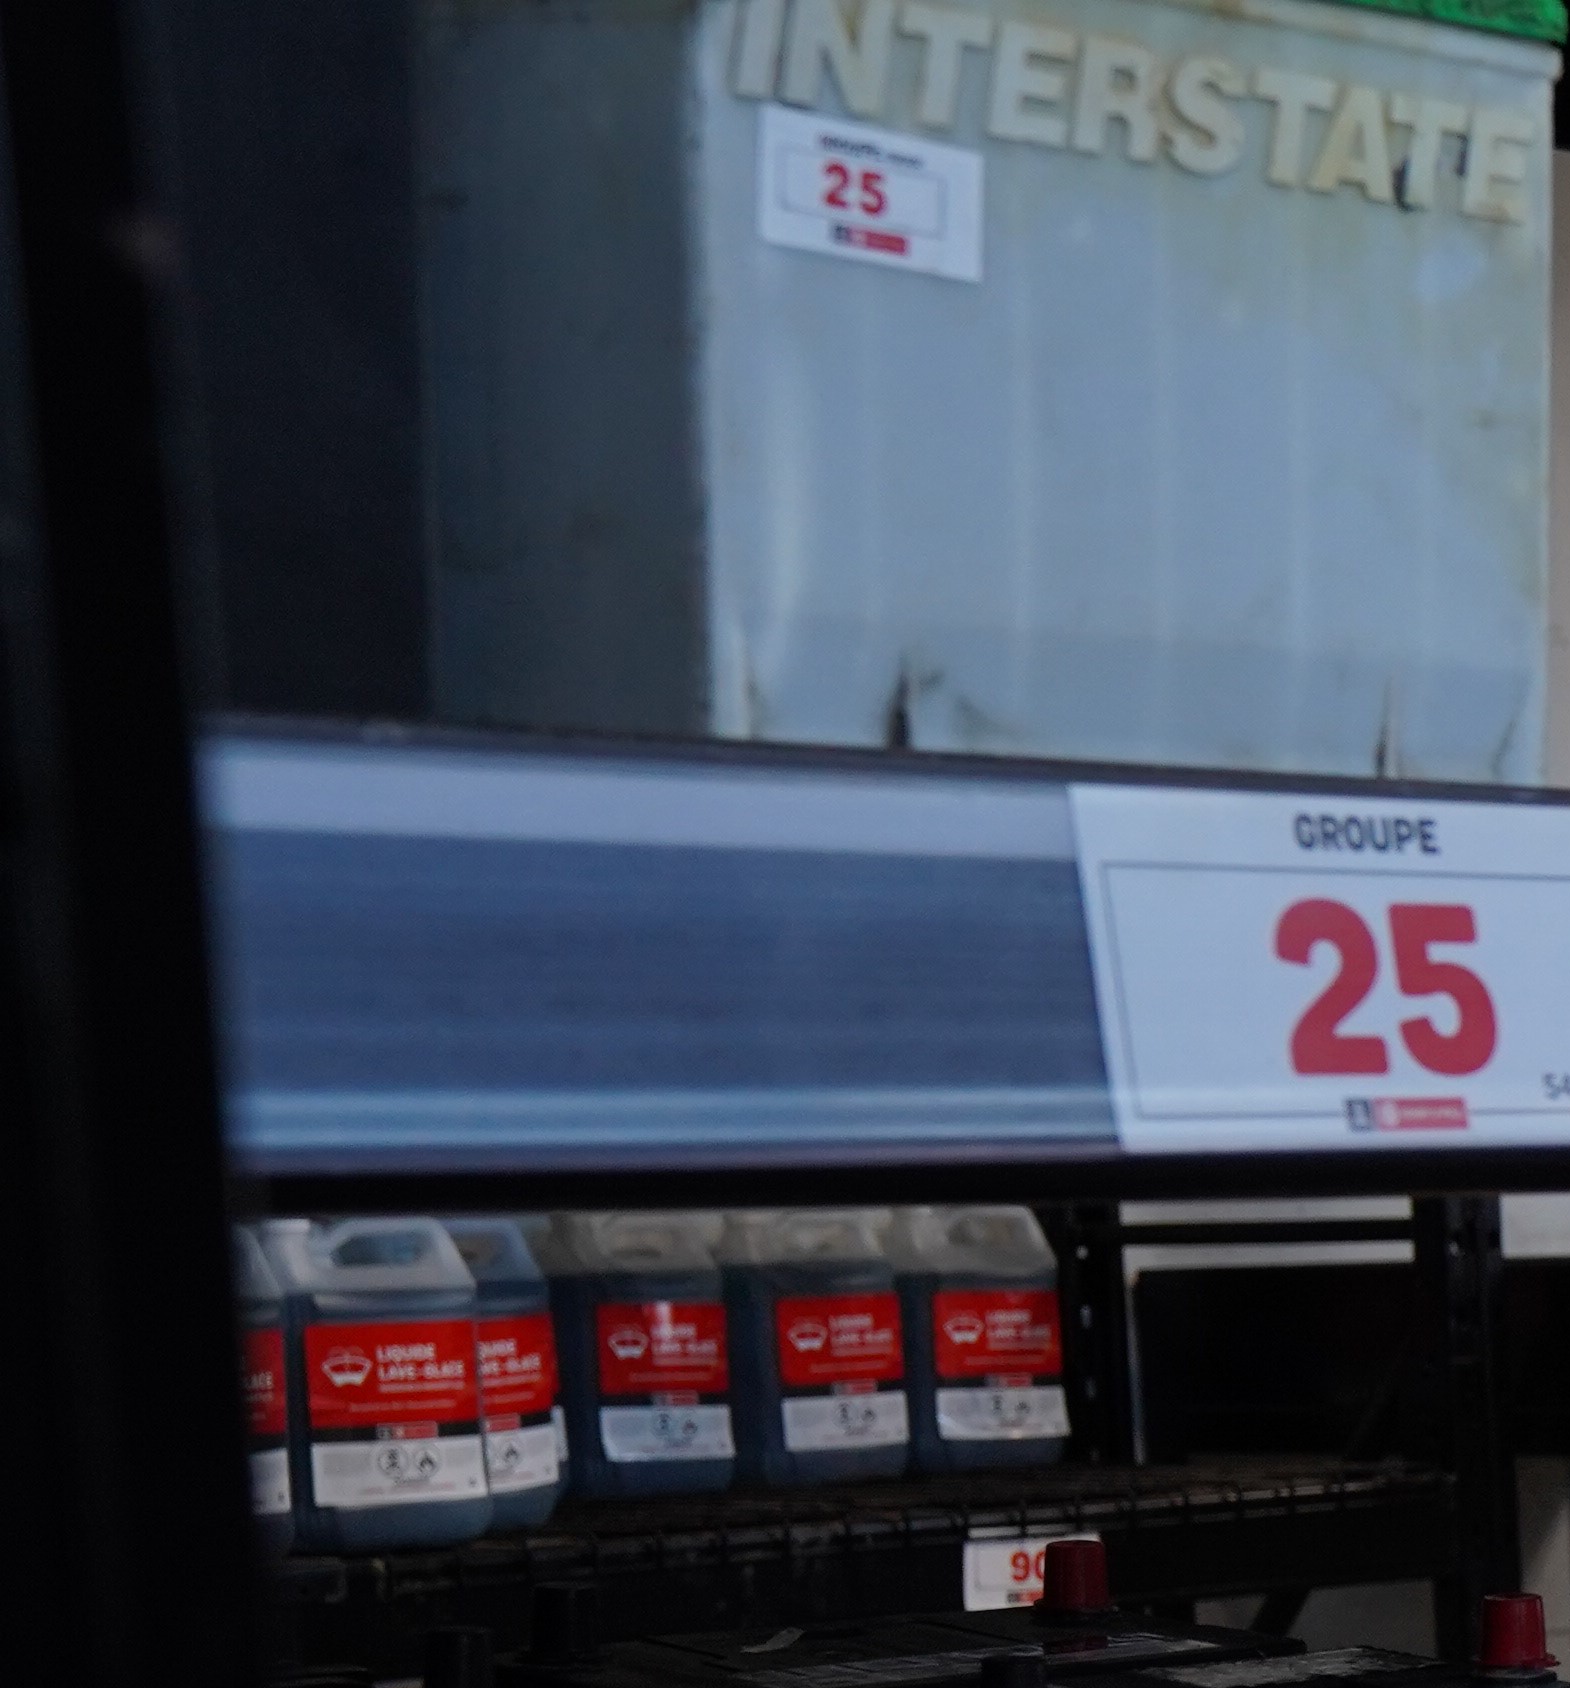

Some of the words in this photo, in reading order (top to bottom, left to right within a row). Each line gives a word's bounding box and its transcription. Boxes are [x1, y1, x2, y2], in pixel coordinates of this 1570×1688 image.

[730, 0, 1538, 228] INTERSTATE
[822, 162, 886, 217] 25
[1294, 813, 1440, 857] GROUPE
[1275, 898, 1497, 1076] 25
